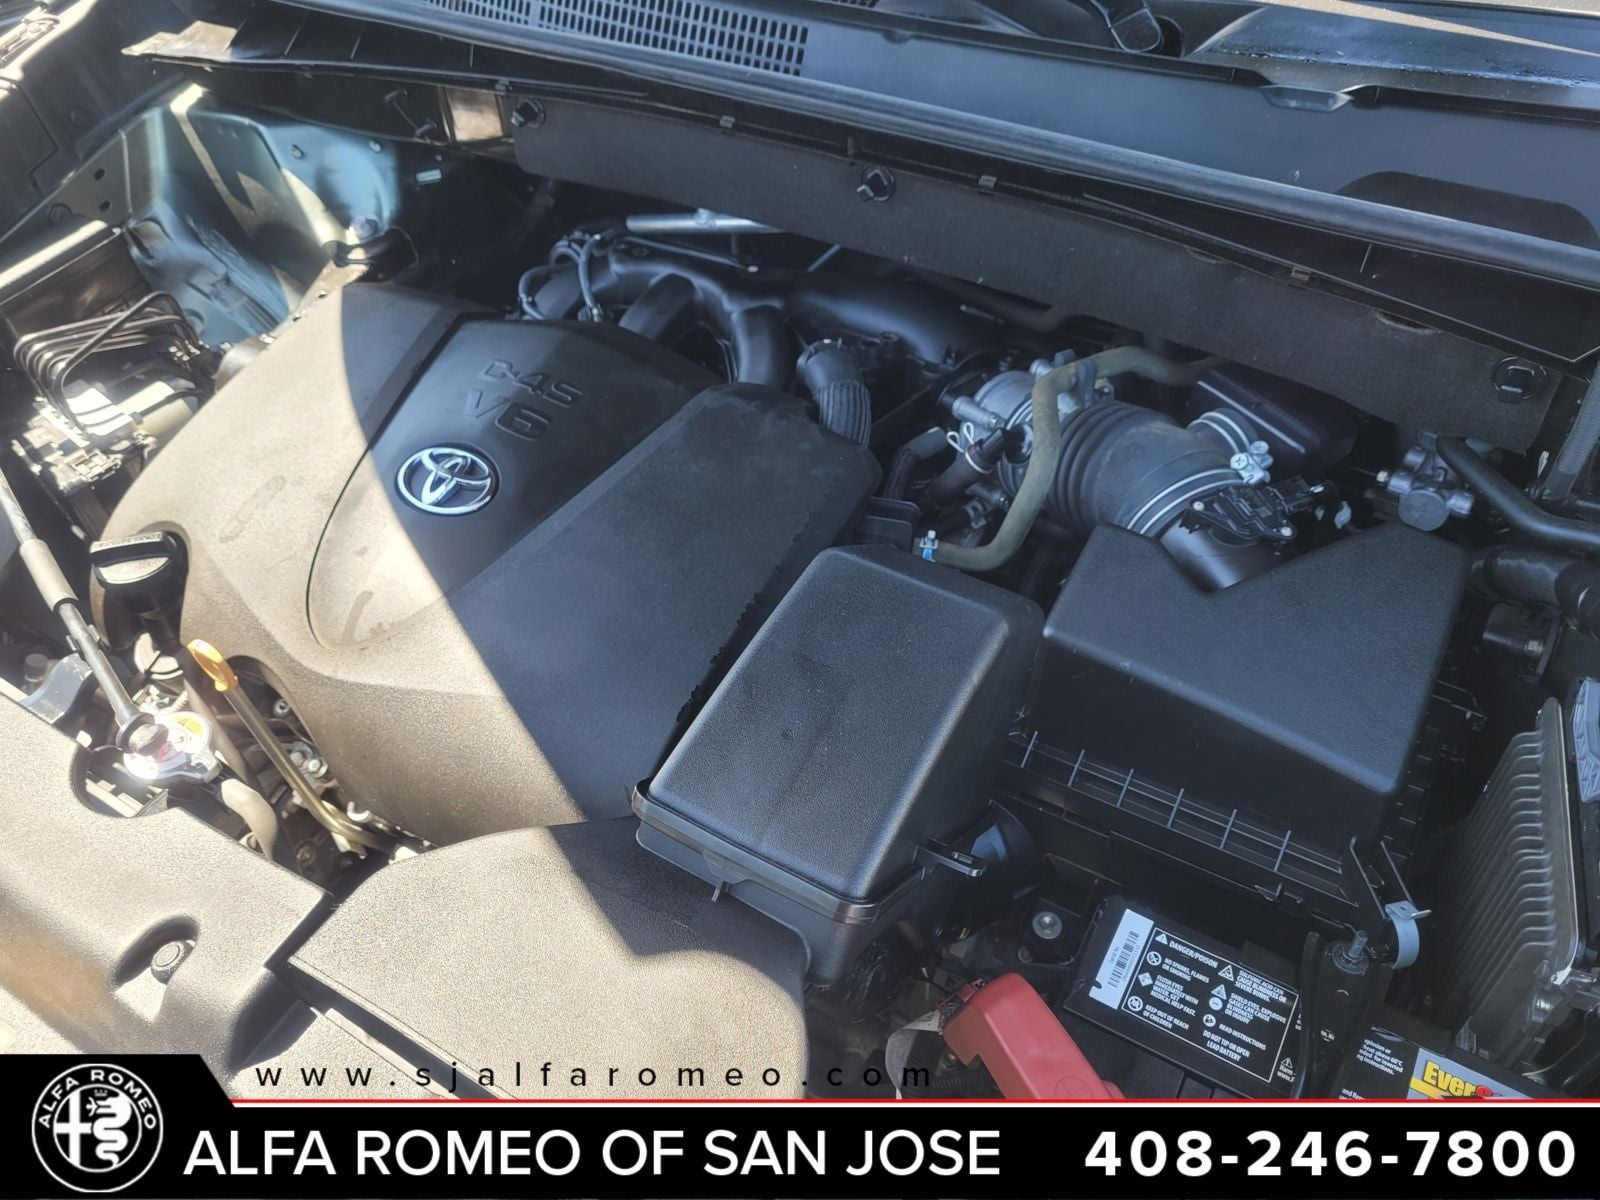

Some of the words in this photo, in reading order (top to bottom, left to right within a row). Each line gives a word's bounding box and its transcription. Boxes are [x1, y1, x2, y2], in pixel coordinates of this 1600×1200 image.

[464, 388, 551, 441] V6
[1169, 941, 1218, 968] DANGER/POISON
[1169, 967, 1191, 981] SMOKING
[1190, 970, 1209, 983] FLAMES
[1171, 981, 1184, 991] EYES
[1235, 981, 1253, 994] SEVERE
[1236, 975, 1253, 987] CAUSE
[1252, 982, 1280, 1000] BLINDNESS
[1261, 980, 1274, 990] ACID
[1273, 986, 1285, 995] CAN
[1150, 990, 1171, 1004] MEDICAL
[1170, 1000, 1184, 1010] HELP
[1170, 993, 1180, 1002] GET
[1145, 1004, 1158, 1013] KEEP
[1157, 1009, 1168, 1018] OUT
[1172, 1018, 1189, 1030] REACH
[1226, 1003, 1254, 1020] BLINDNESS
[1228, 998, 1245, 1010] GASES
[1244, 1006, 1255, 1014] CAN
[1254, 1011, 1271, 1022] CAUSE
[1230, 993, 1248, 1005] SHIELD
[1260, 1007, 1287, 1024] EXPLOSIVE
[1149, 1013, 1172, 1028] CHILDREN
[1202, 1029, 1212, 1038] DO
[1210, 1033, 1221, 1043] NOT
[1220, 1038, 1230, 1046] TIP
[1229, 1043, 1238, 1051] OR
[1236, 1047, 1251, 1058] OPEN
[1219, 1023, 1233, 1034] READ
[1231, 1030, 1267, 1051] INSTRUCTIONS
[1206, 1040, 1221, 1051] LEAD
[1219, 1047, 1242, 1062] BATTERY
